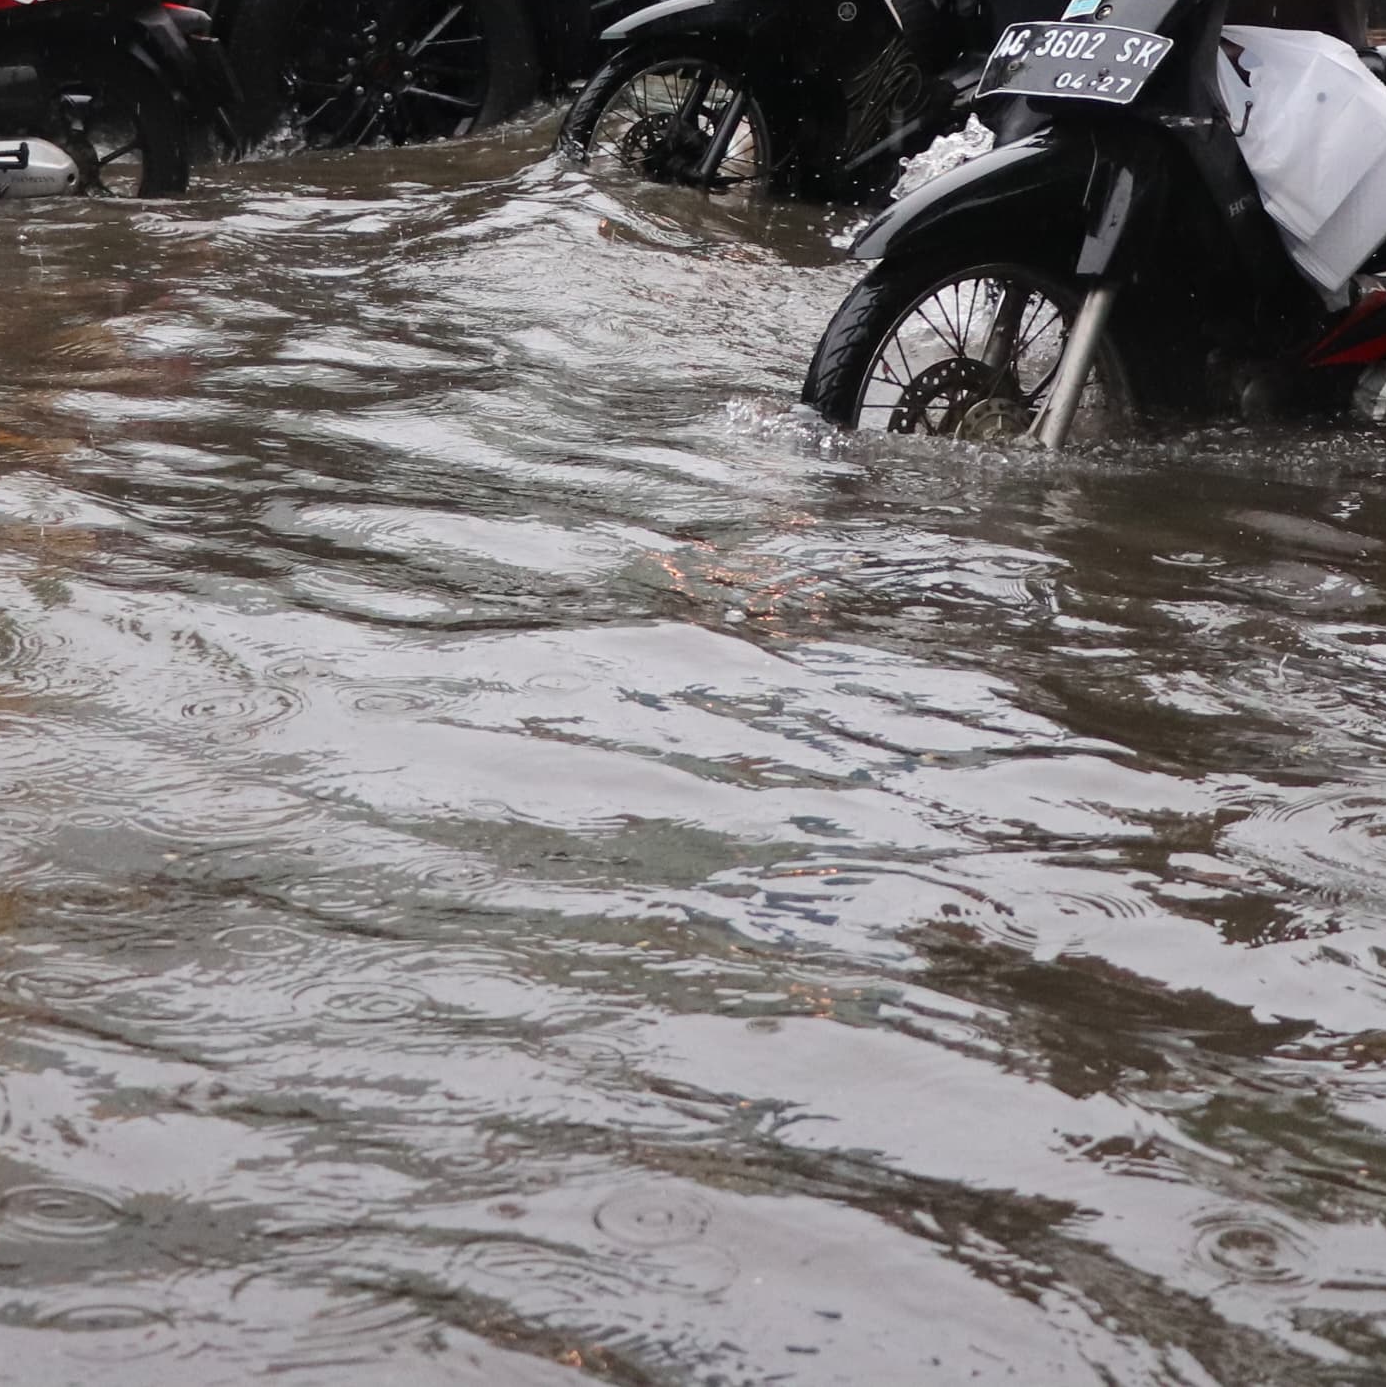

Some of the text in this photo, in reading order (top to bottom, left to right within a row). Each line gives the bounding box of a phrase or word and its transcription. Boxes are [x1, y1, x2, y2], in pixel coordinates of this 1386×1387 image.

[994, 28, 1163, 68] AG 3602 SK
